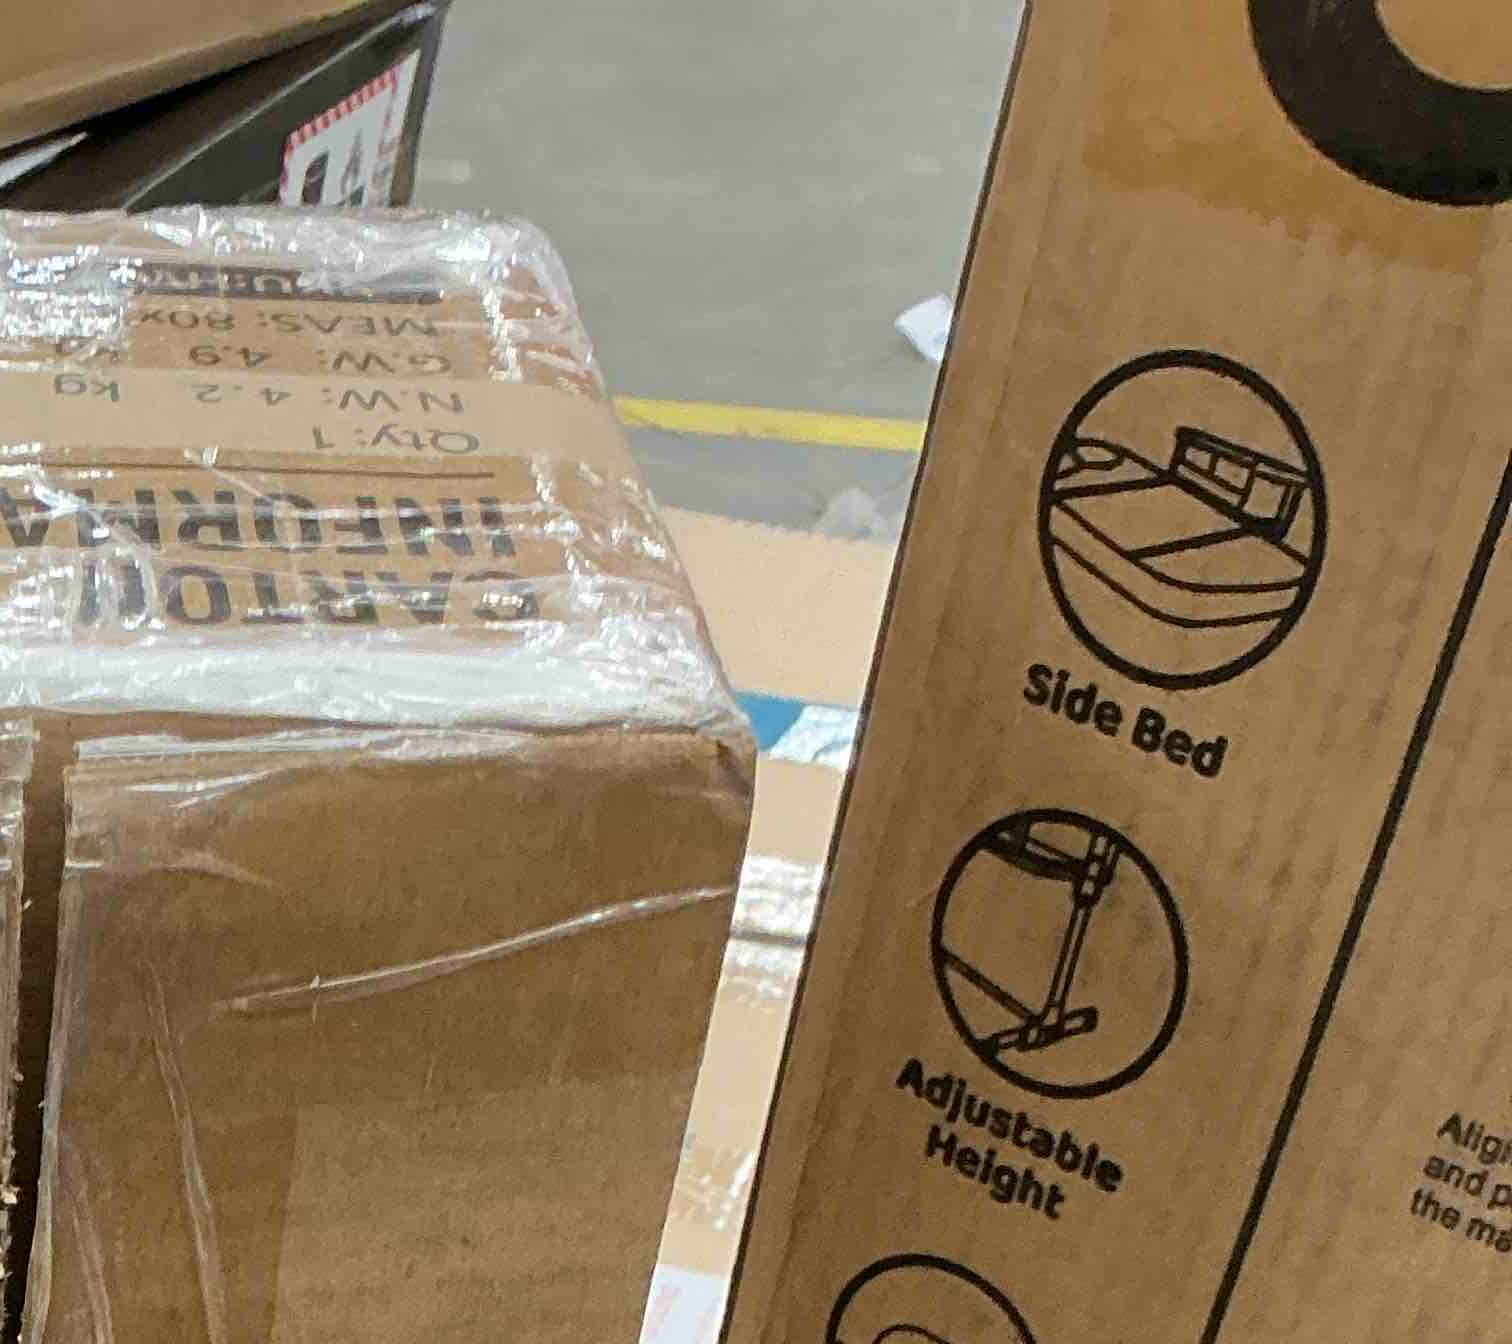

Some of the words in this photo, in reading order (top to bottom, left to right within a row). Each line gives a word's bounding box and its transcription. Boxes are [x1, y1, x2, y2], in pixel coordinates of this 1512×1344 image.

[189, 345, 274, 369] 4.9
[315, 350, 452, 376] G.W:
[53, 373, 120, 402] kg
[193, 383, 292, 407] 4.2
[324, 389, 465, 415] N.W:
[313, 427, 335, 450] 1
[354, 427, 480, 454] Qty:
[1023, 662, 1124, 740] Side
[1131, 708, 1229, 778] Bed
[896, 1057, 1124, 1194] Adjustable
[926, 1126, 1067, 1222] Height
[1424, 1155, 1488, 1196] and
[1410, 1188, 1461, 1231] the
